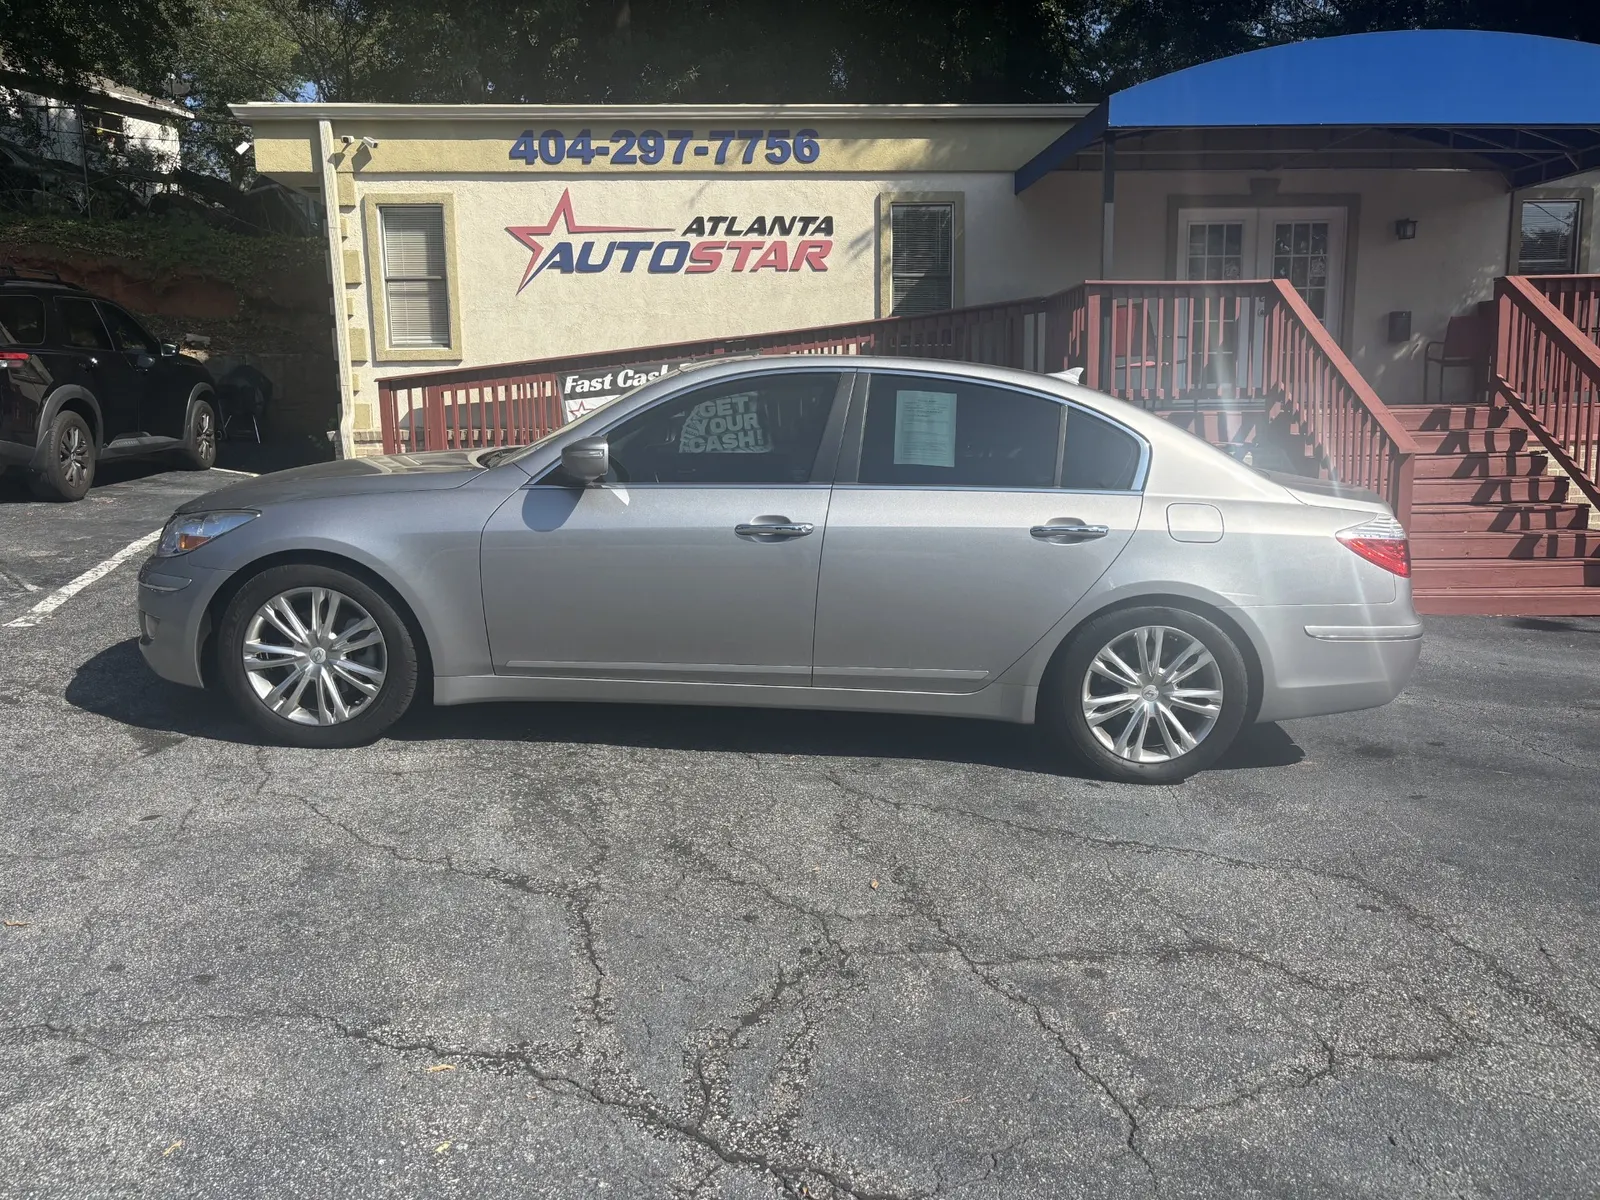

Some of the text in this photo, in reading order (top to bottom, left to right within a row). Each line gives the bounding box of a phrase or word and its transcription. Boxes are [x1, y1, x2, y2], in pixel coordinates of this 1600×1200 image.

[508, 128, 821, 166] 404-297-7756
[681, 215, 834, 237] ATLANTA
[546, 240, 834, 275] AUTOSTAR
[564, 373, 613, 394] Fast
[700, 396, 749, 417] GET
[694, 412, 760, 436] YOUR
[689, 429, 764, 453] CASH!
